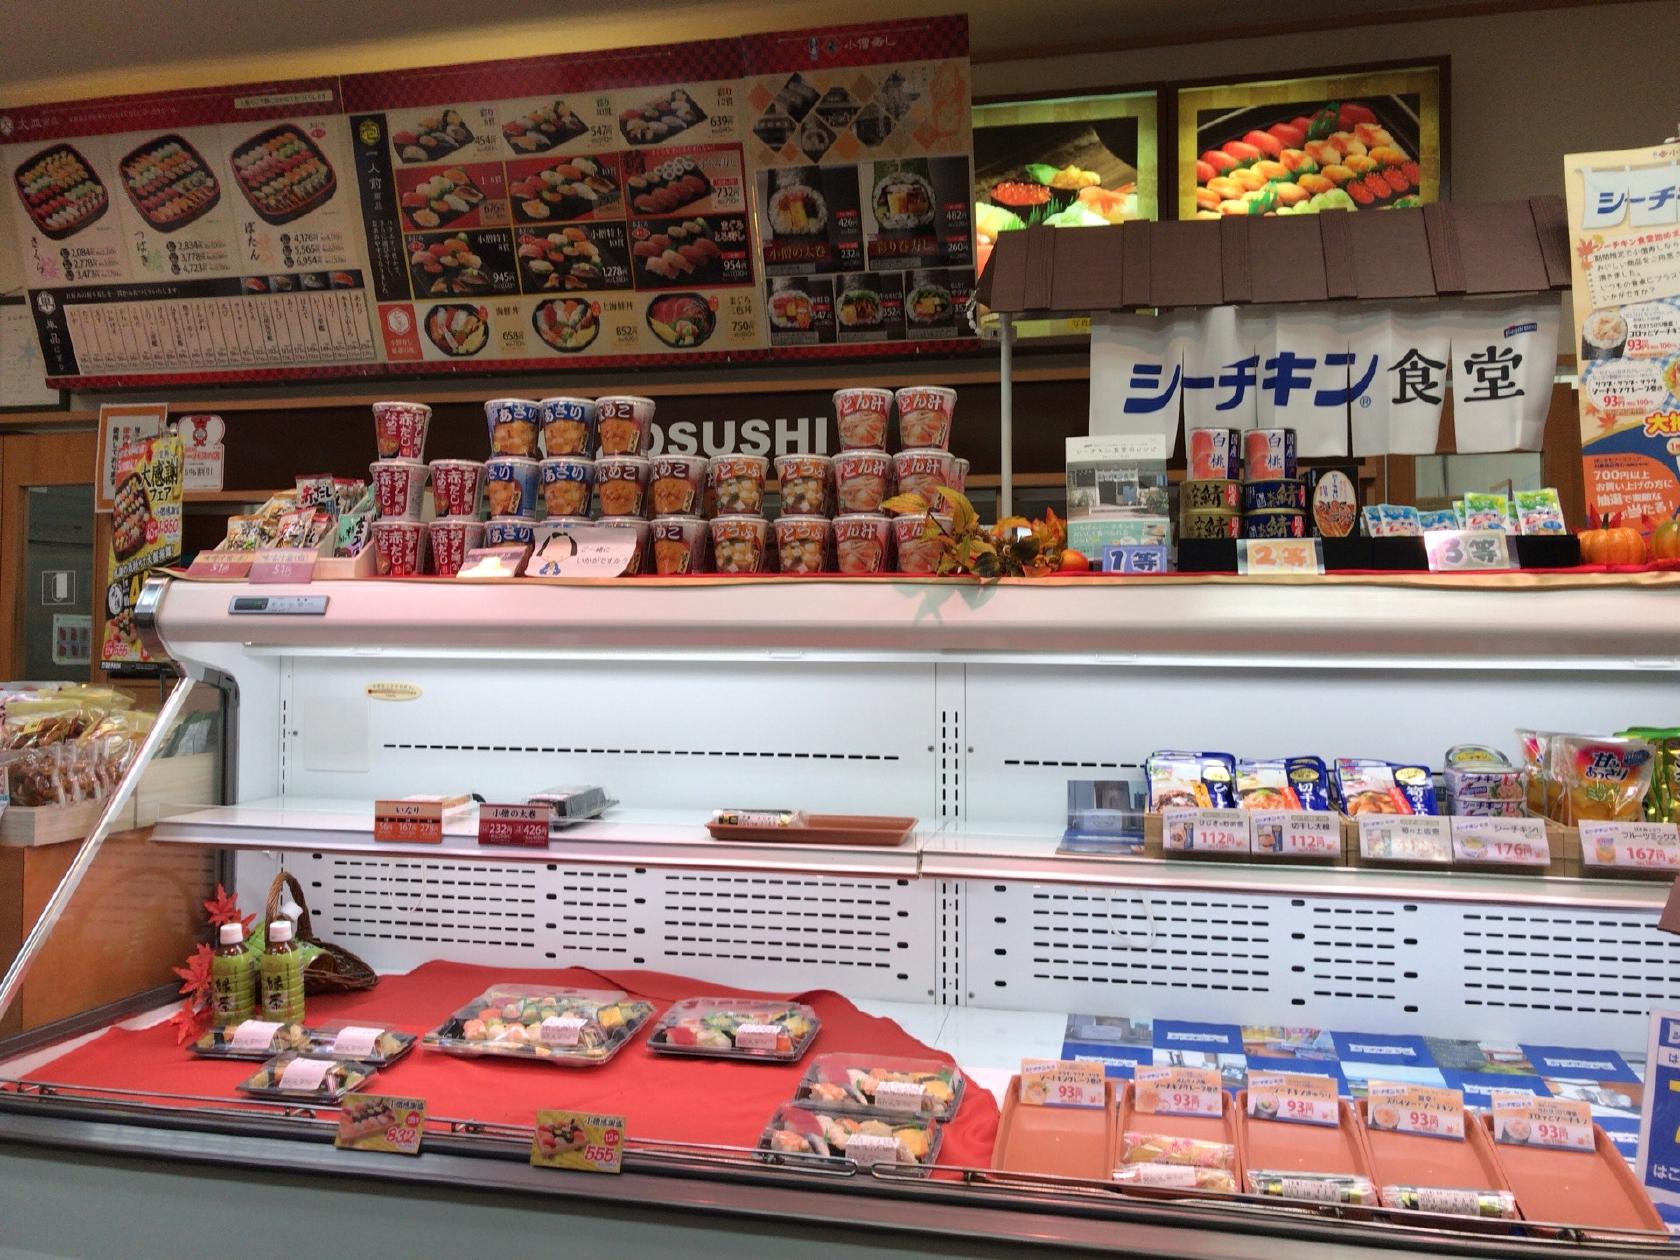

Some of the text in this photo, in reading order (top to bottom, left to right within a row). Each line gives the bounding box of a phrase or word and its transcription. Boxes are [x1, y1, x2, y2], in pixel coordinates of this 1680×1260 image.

[1597, 186, 1680, 214] シーチ
[723, 261, 747, 270] 954円
[492, 272, 515, 282] 945円
[1123, 345, 1525, 414] シーチキン 食堂
[498, 405, 540, 423] あさり
[543, 405, 583, 422] あさり
[398, 410, 413, 447] 赤だし
[1210, 434, 1225, 468] 白桃
[1268, 434, 1282, 468] 白桃
[544, 465, 584, 481] あさり
[718, 463, 761, 478] とうふ
[785, 462, 826, 477] とうふ
[1593, 470, 1650, 480] 700円以上
[149, 486, 172, 502] フェア
[380, 471, 393, 506] 赤だし
[447, 471, 461, 506] 赤だし
[489, 526, 531, 543] あさり
[713, 524, 755, 539] とうふ
[783, 526, 824, 541] とうふ
[897, 526, 925, 541] とん
[389, 530, 403, 565] 赤だし
[1444, 538, 1497, 564] 3等
[1110, 550, 1160, 571] 1等
[1254, 545, 1307, 566] 2等
[395, 806, 420, 815] いなり
[492, 809, 537, 819] 小僧の太巻
[489, 824, 548, 836] 232円 426円
[1201, 832, 1235, 845] 112円
[1290, 835, 1325, 848] 112円
[1494, 843, 1533, 856] 176円
[1626, 848, 1666, 861] 167円
[1058, 1086, 1083, 1098] 93円
[1173, 1093, 1200, 1106] 93円
[1288, 1100, 1313, 1114] 93円
[1410, 1111, 1438, 1128] 93円
[1539, 1124, 1568, 1139] 93円
